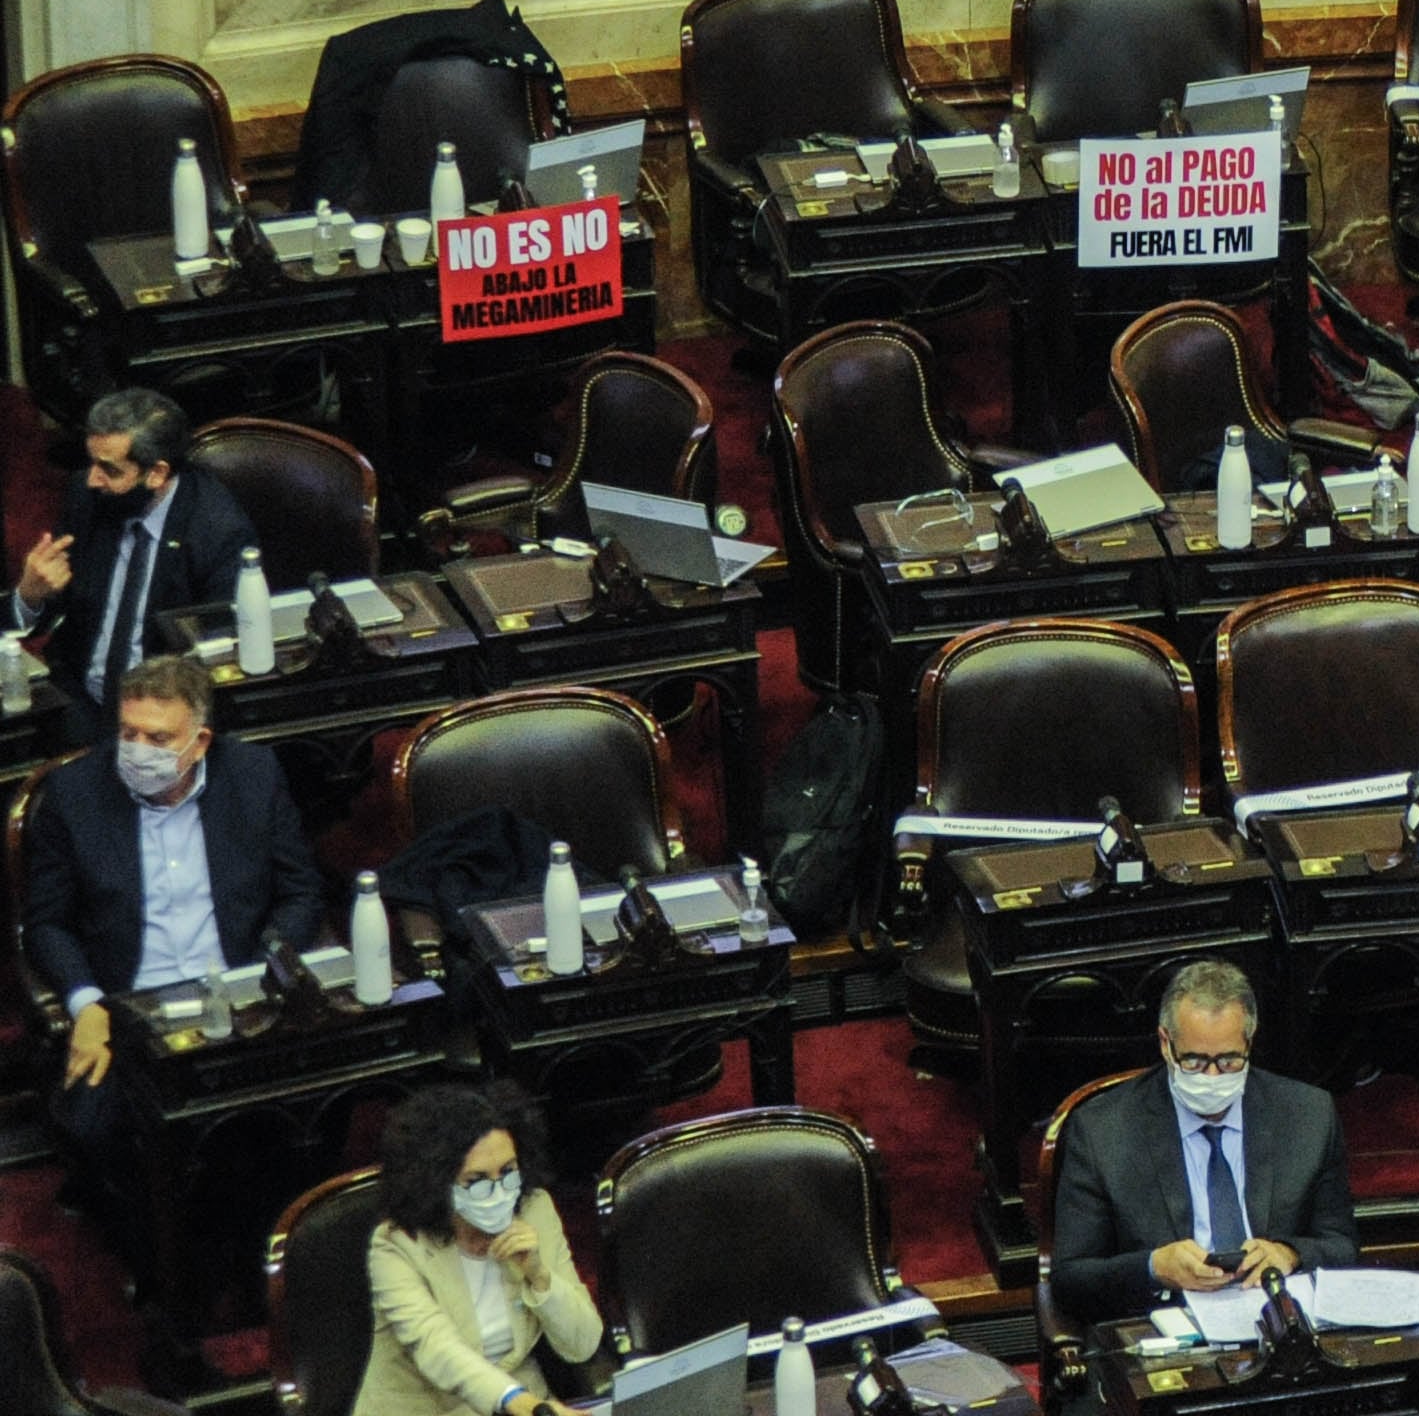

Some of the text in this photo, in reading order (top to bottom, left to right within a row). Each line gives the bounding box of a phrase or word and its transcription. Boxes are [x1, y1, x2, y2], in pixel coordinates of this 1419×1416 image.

[1098, 146, 1255, 186] NO al PAGO
[1094, 181, 1266, 222] de la DEUDA
[447, 209, 608, 272] NO ES NO
[1110, 225, 1254, 259] FUERA EL FMI
[482, 262, 576, 297] ABAJO LA
[451, 281, 613, 331] MEGAMINERIA
[943, 822, 1005, 833] Reservado
